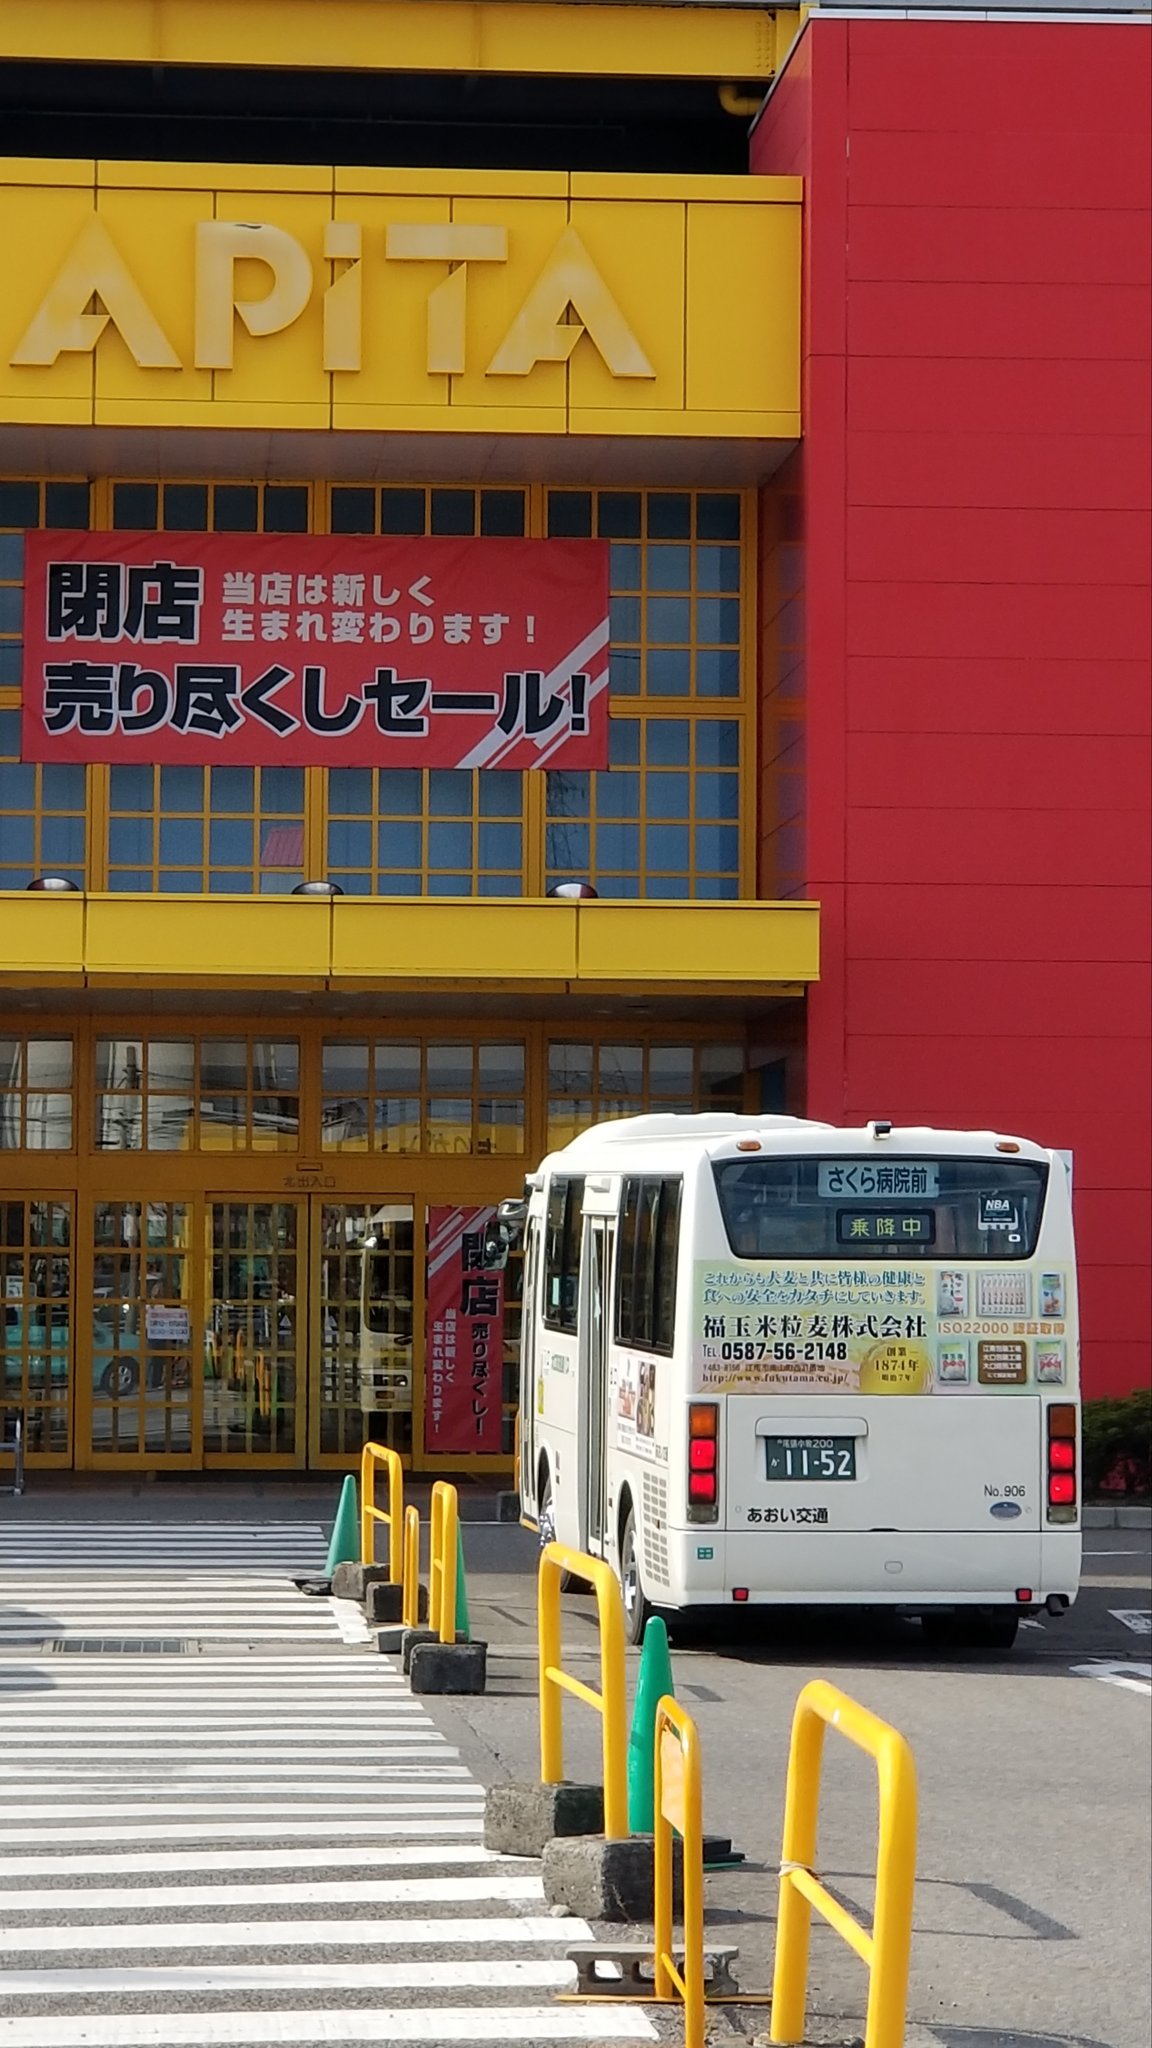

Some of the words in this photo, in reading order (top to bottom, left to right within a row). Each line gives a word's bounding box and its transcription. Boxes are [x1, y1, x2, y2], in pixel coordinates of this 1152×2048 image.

[9, 214, 656, 378] APITA
[222, 571, 435, 607] 当店は新しく
[48, 562, 204, 644] 閉店
[221, 608, 536, 645] 生まれ変わります！
[43, 661, 591, 739] 売り尽くしセール!
[828, 1167, 927, 1193] さくら病院前
[986, 1200, 1010, 1211] NBA
[850, 1218, 921, 1237] 乗降中
[704, 1270, 925, 1286] これからも大麦と共に皆様の健康と
[704, 1289, 925, 1305] 食への安全をカタチにしていきます。
[703, 1314, 928, 1339] 福玉米粒麦株式会社
[938, 1322, 1009, 1334] ISO22000
[721, 1342, 847, 1361] 0587-56-2148
[702, 1373, 848, 1385] http://www.fukutama.co.jp/
[786, 1449, 852, 1476] 11-52
[984, 1485, 1026, 1498] No.906
[747, 1508, 829, 1524] あおい交通
